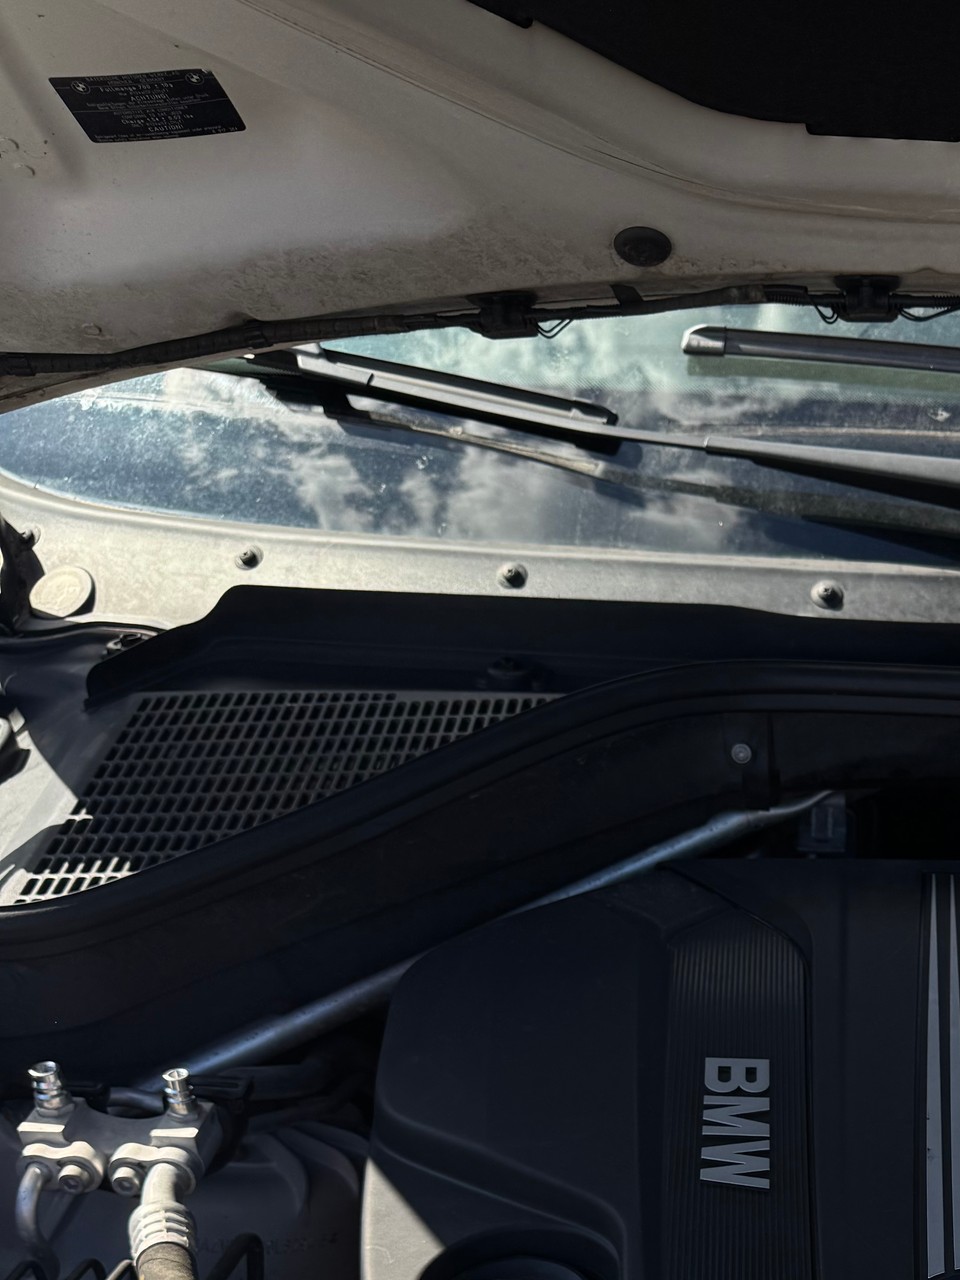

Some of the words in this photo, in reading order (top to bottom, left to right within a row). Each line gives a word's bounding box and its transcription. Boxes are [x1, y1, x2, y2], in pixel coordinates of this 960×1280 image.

[130, 93, 170, 102] ACHTUNG!
[148, 124, 184, 132] CAUTION!
[699, 1056, 771, 1190] BMW
